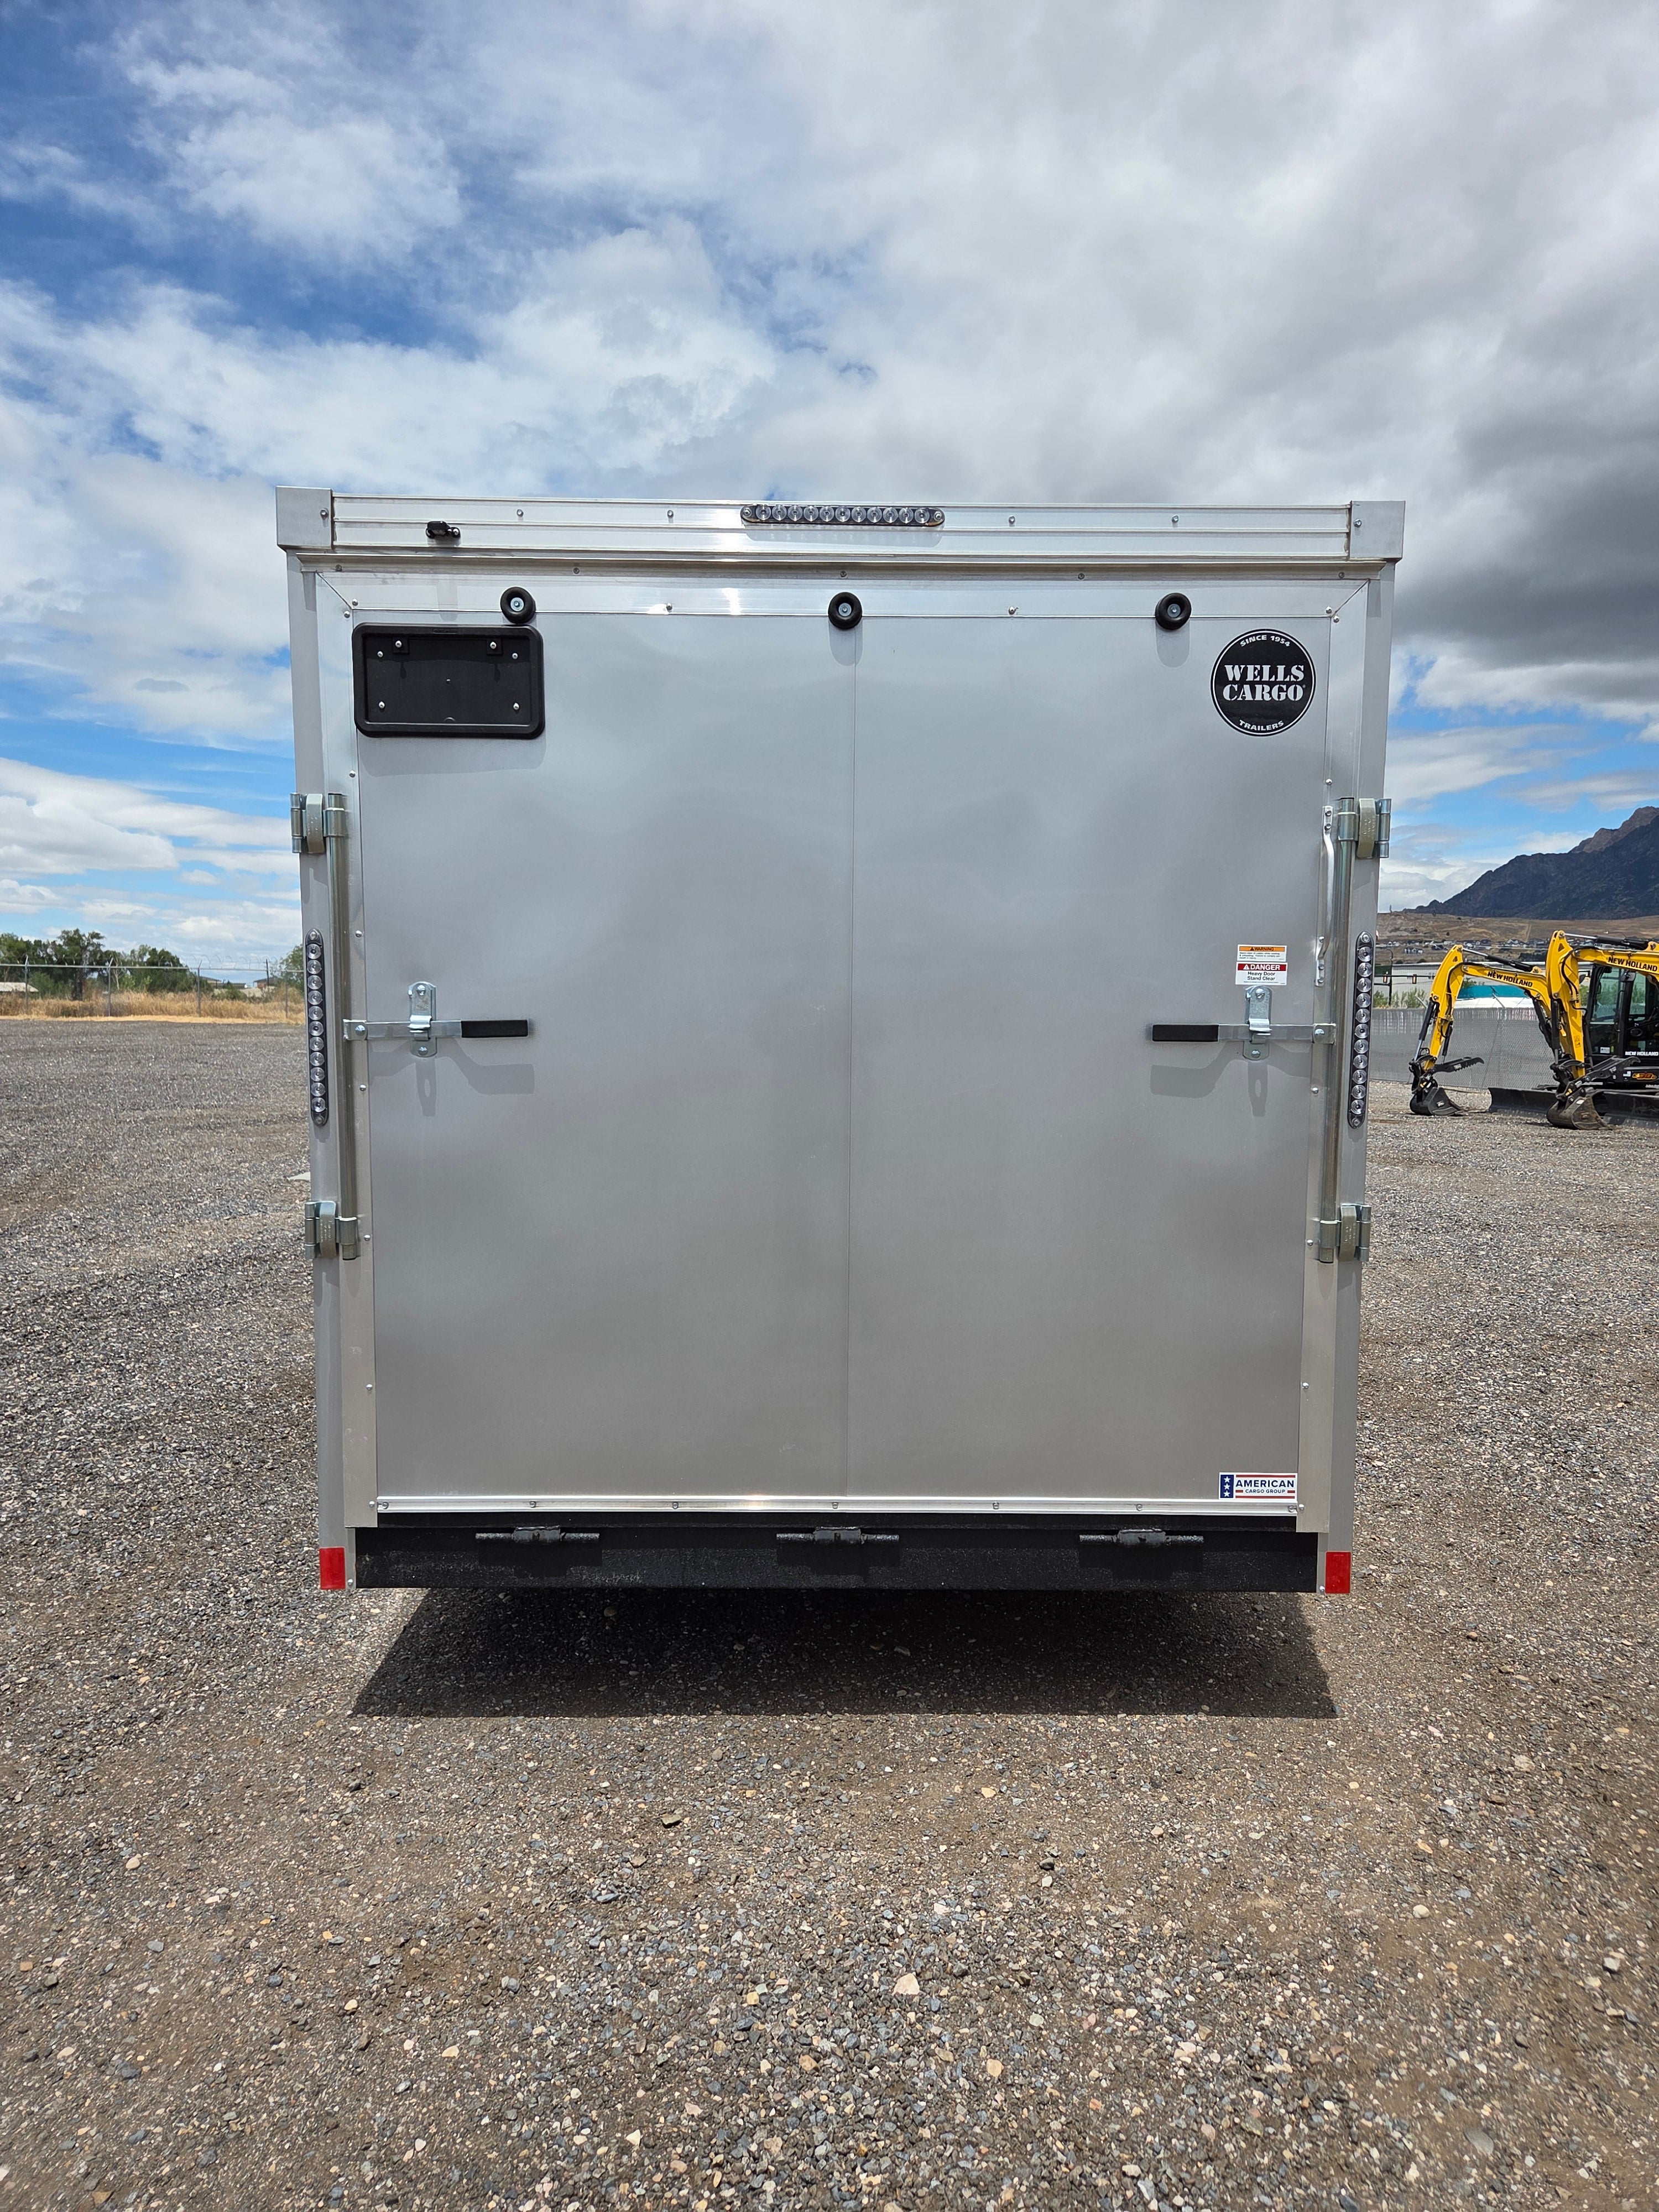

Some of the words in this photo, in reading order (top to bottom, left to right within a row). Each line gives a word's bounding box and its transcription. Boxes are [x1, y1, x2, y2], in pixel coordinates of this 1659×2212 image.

[1240, 635, 1267, 646] SINCE
[1270, 635, 1290, 646] 1954
[1224, 665, 1305, 681] WELLS
[1223, 684, 1303, 701] CARGO
[1239, 719, 1284, 731] TRAILERS
[1608, 956, 1625, 965] NEW
[1625, 959, 1658, 972] HOLLAND
[1488, 971, 1503, 979] NEW
[1504, 975, 1533, 987] HOLLAND
[1235, 1479, 1294, 1488] AMERICAN
